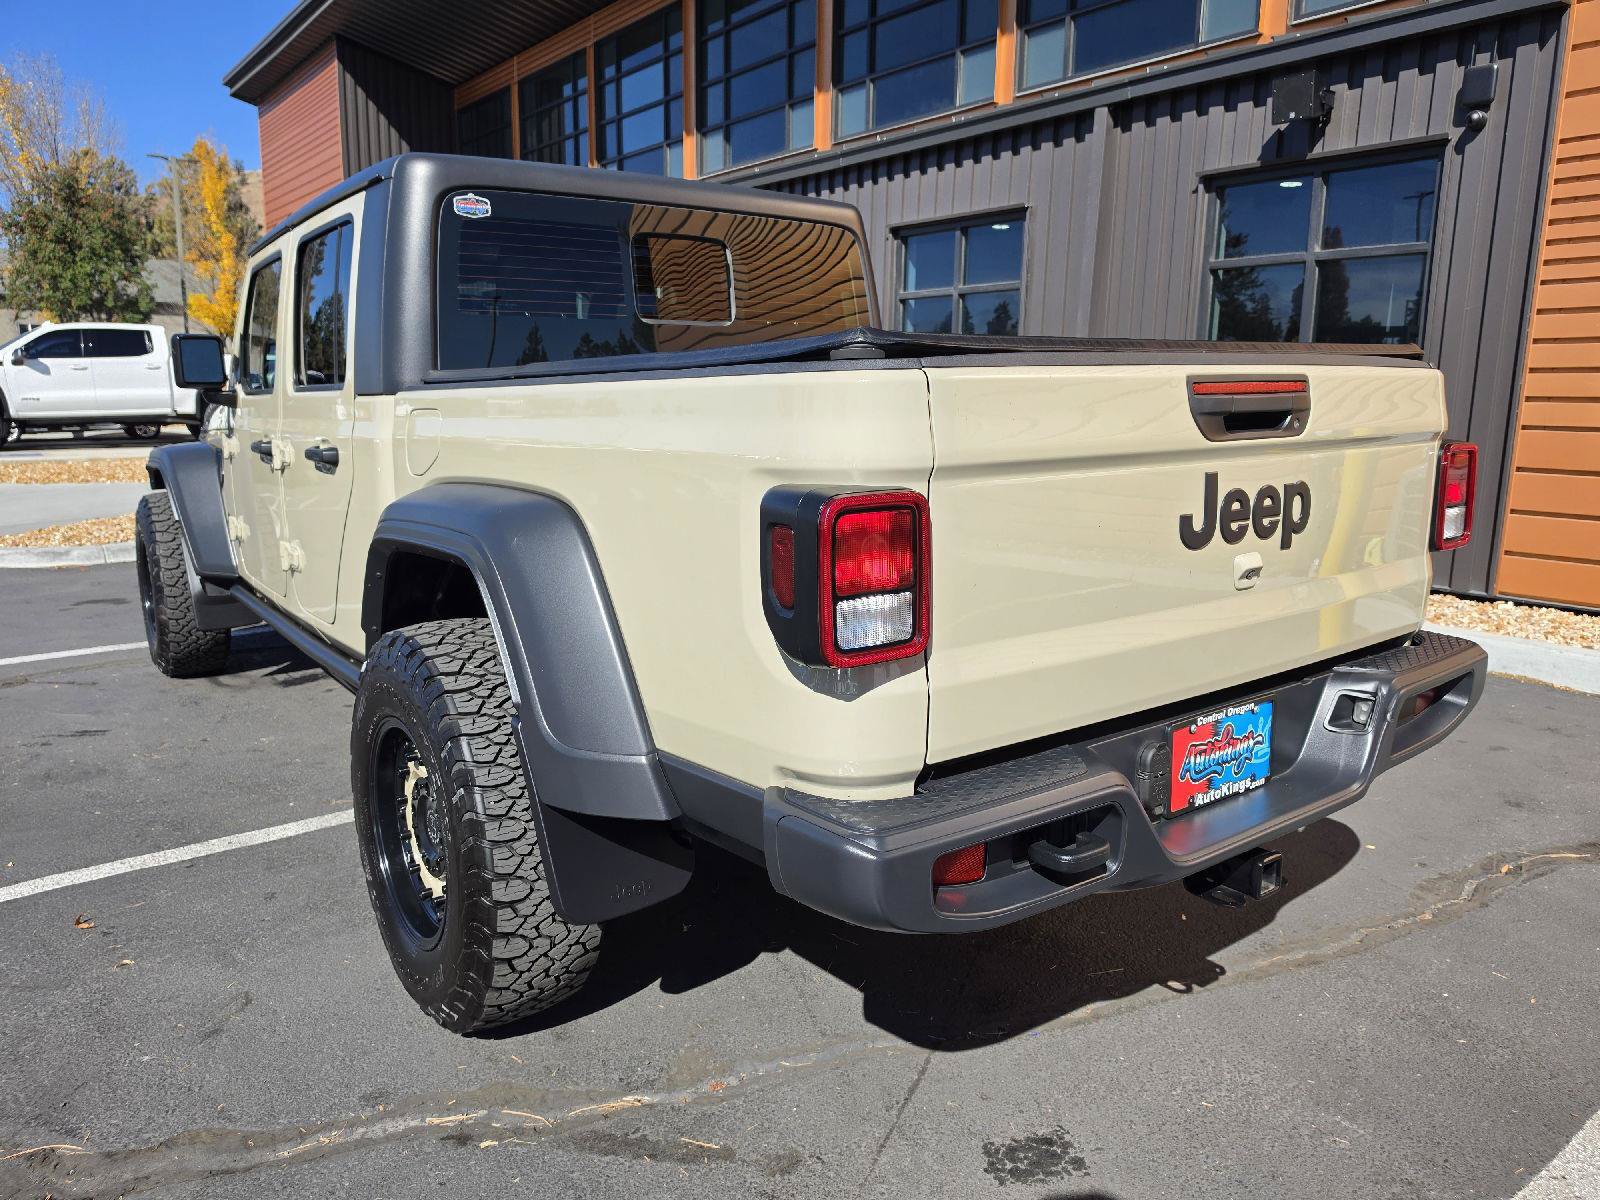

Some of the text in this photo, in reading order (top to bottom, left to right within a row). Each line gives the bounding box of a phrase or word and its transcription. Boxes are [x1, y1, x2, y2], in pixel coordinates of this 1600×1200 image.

[1179, 471, 1311, 551] Jeep
[1197, 703, 1255, 725] Central Oregon
